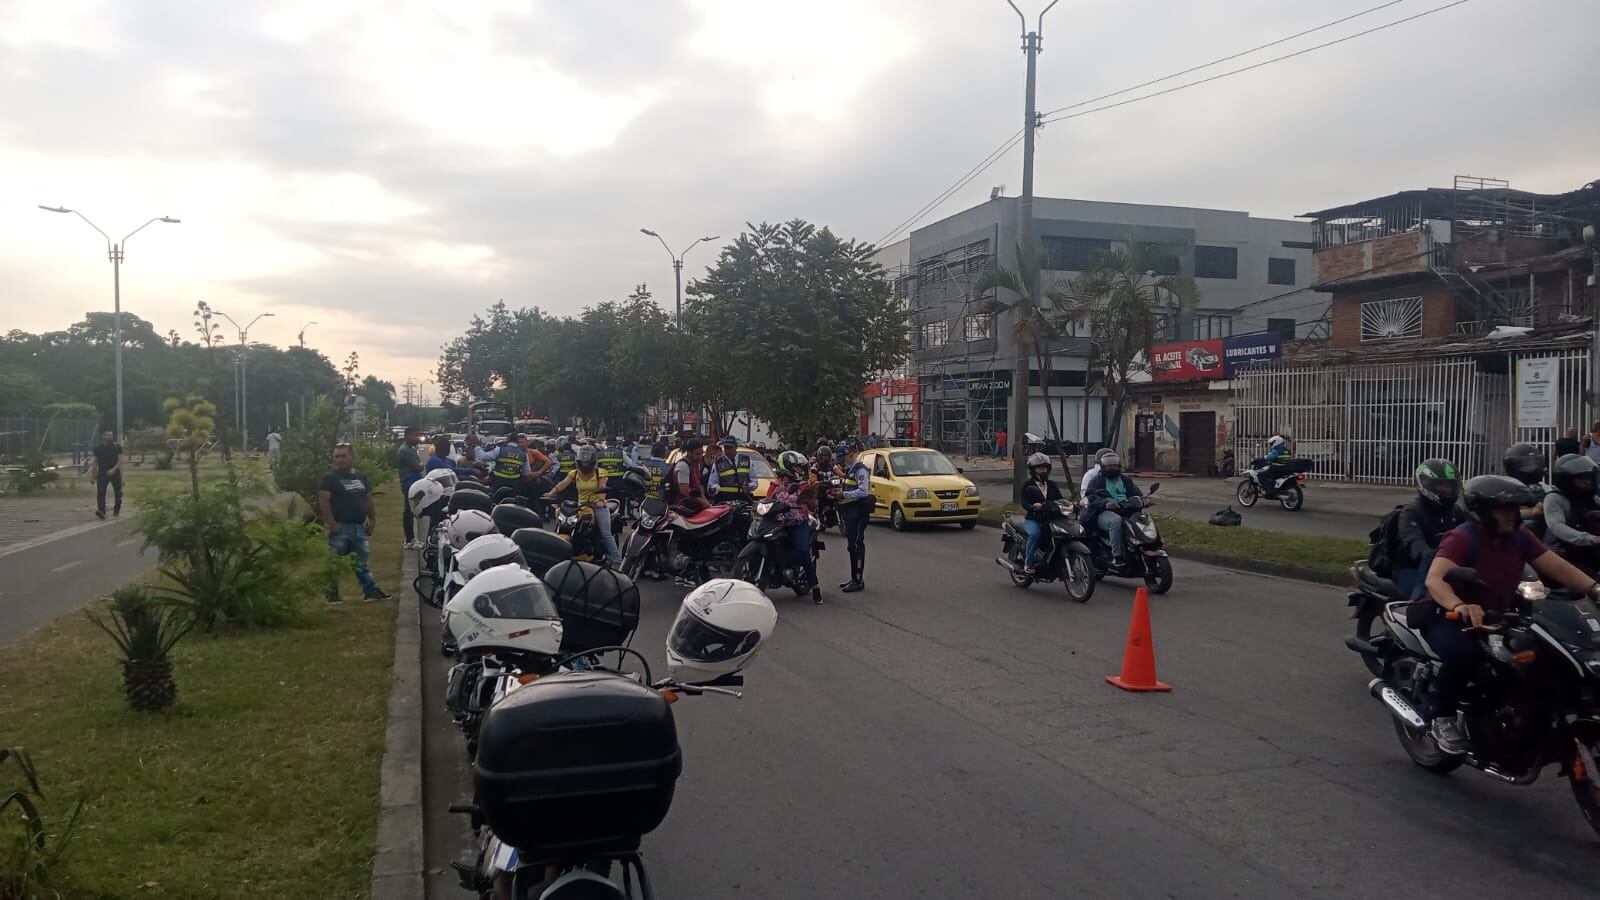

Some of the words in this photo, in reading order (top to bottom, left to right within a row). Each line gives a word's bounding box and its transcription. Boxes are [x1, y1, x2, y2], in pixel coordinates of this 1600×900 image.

[1155, 353, 1162, 362] EL
[1163, 351, 1182, 361] ACEITE
[1226, 345, 1267, 357] LUBRICANTES
[1268, 344, 1276, 353] W
